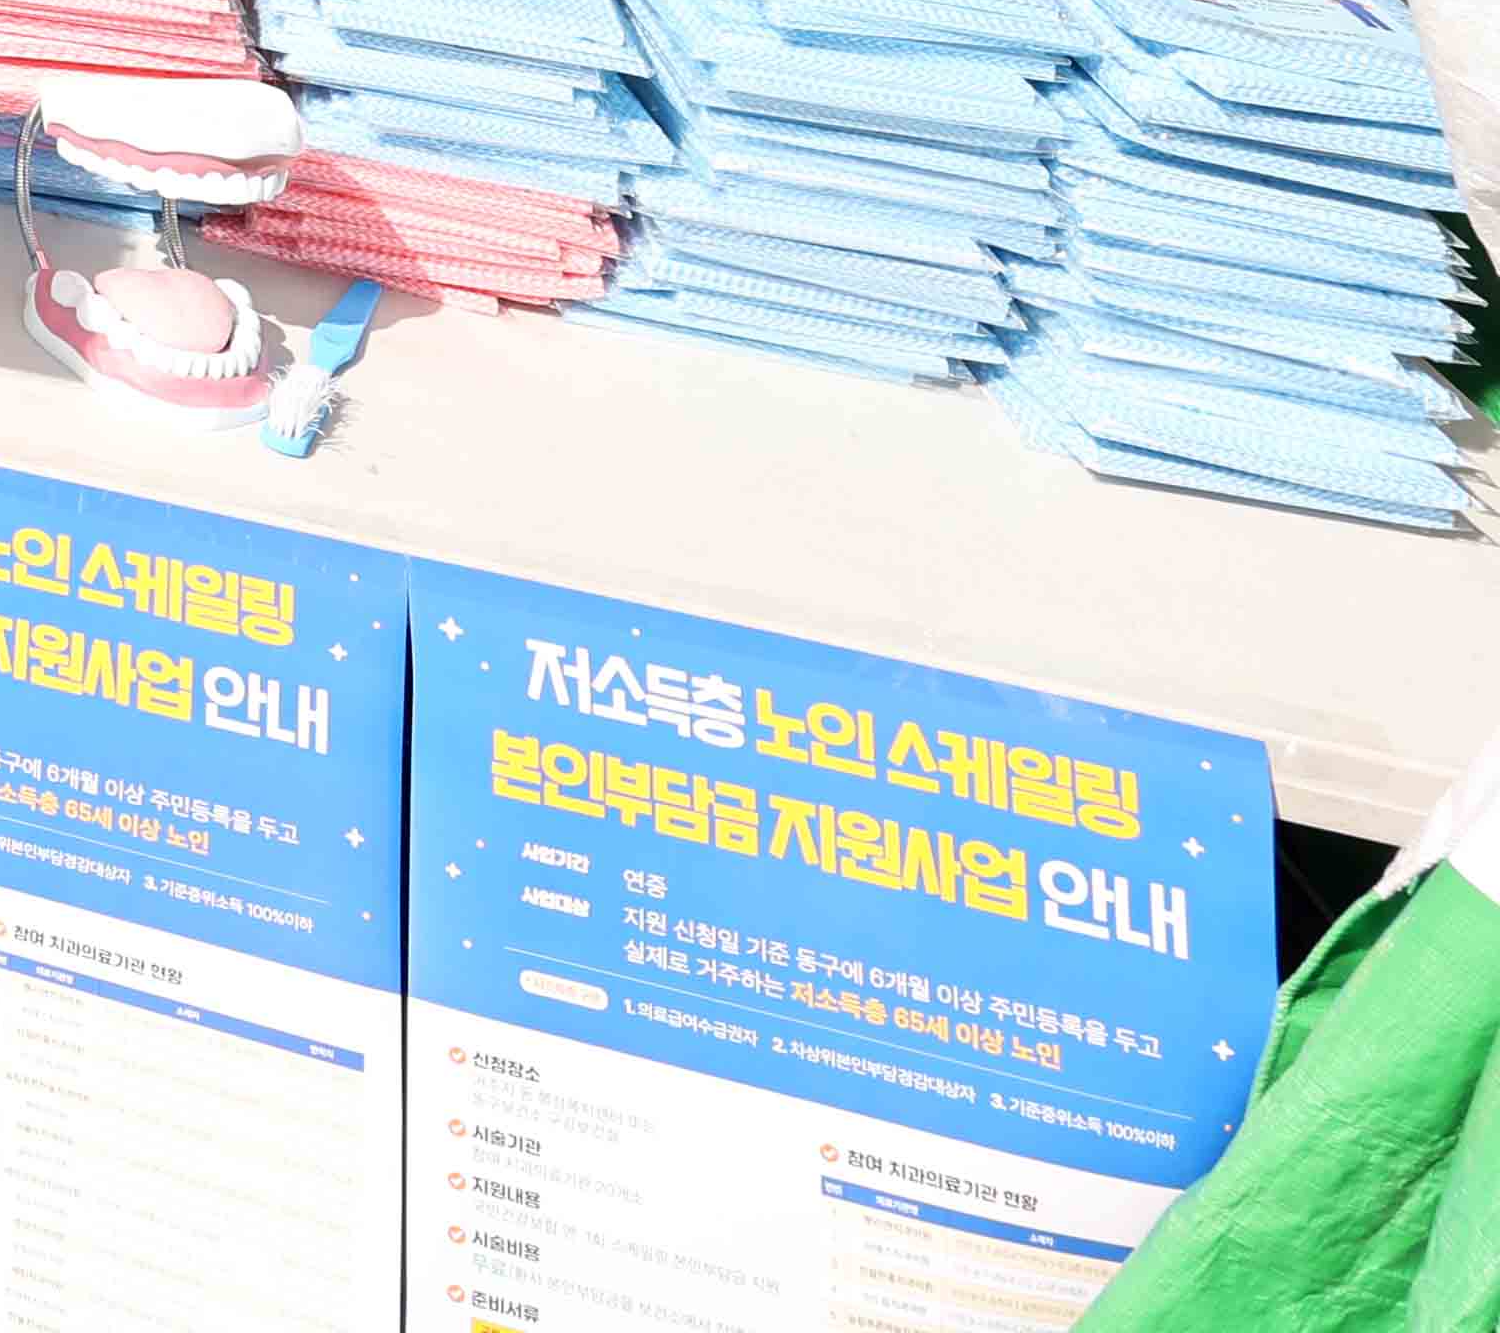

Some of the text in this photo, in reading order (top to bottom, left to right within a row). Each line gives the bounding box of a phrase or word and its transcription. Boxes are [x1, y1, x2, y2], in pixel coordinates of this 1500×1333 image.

[78, 542, 296, 647] 스케일링
[203, 665, 329, 755] 안내
[525, 637, 1141, 839] 저소득층 노인 스케일링
[47, 763, 100, 795] 6개월
[104, 778, 145, 806] 이상
[150, 789, 253, 834] 주민등록을
[257, 816, 301, 846] 두고
[64, 799, 114, 831] 65세
[118, 812, 161, 843] 이상
[166, 825, 210, 857] 노인
[491, 728, 1190, 961] 본인부담금 지원사업 안내
[521, 841, 668, 899] 사업기간 연중
[247, 901, 315, 934] 100%이하
[12, 923, 46, 950] 참여
[49, 934, 147, 976] 치과의료기관
[521, 886, 1164, 1060] 사업대상 지원 신청일 기준 동구에 6개월 이상 주민등록을 두고
[623, 938, 1063, 1071] 실제로 거주하는 저소득층 65세 이상 노인
[472, 1050, 542, 1084] 신청장소
[638, 1002, 759, 1047] 의료급여수급권자
[1106, 1121, 1177, 1153] 100%이하
[472, 1124, 542, 1159] 시술기관
[472, 1176, 542, 1210] 지원내용
[847, 1148, 1040, 1214] 참여 치과의료기관 현황
[471, 1229, 541, 1263] 시술비용
[471, 1288, 541, 1326] 준비서류
